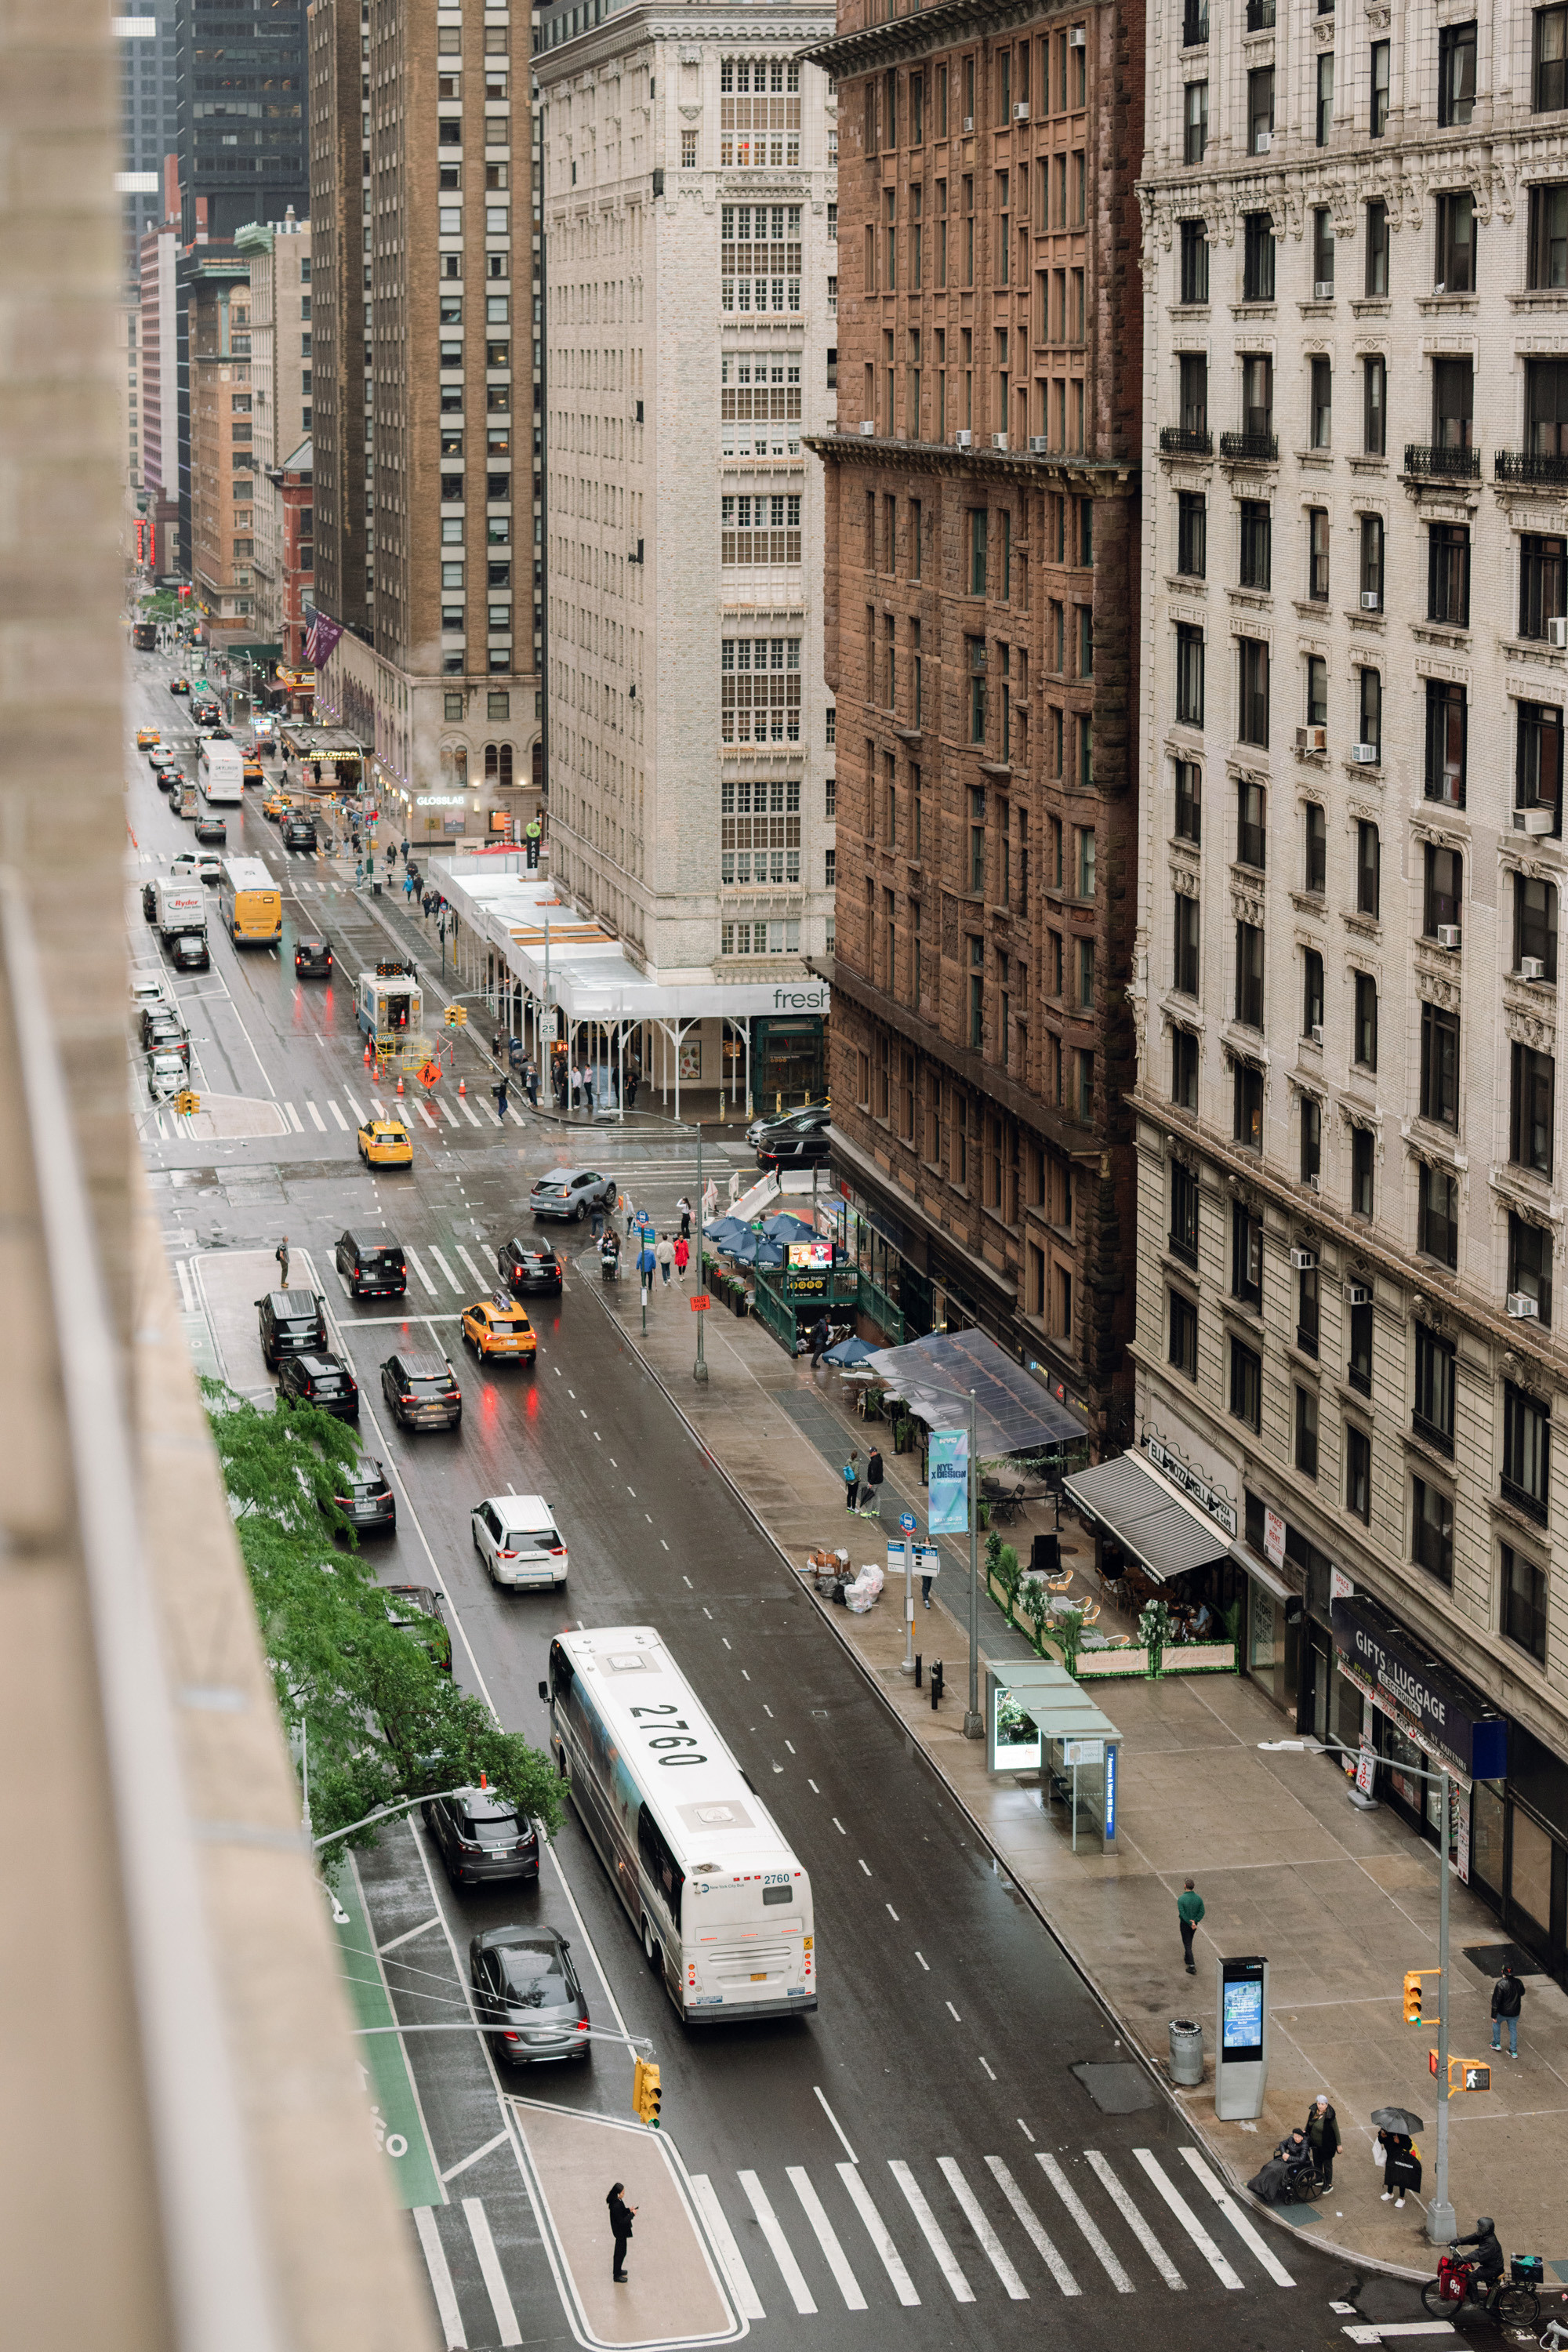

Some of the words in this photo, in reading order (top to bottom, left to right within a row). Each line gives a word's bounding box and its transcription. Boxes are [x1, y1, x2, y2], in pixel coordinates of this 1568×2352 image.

[417, 796, 464, 805] GLOSSLAB
[1169, 1459, 1211, 1505] MOZZRELLA
[1268, 1512, 1283, 1530] SPACE
[1269, 1530, 1280, 1544] RENT
[1335, 1573, 1349, 1592] SPACE
[1354, 1662, 1362, 1674] NY
[1365, 1672, 1372, 1683] PD
[1356, 1630, 1385, 1671] GIFTS
[1394, 1662, 1446, 1726] LUGGAGE
[1381, 1674, 1419, 1715] ELECTRONICS
[1403, 1706, 1417, 1726] TAXI
[630, 1704, 707, 1766] 2760
[1430, 1732, 1438, 1744] NY
[1440, 1741, 1467, 1772] SOUVENIRS
[1361, 1762, 1367, 1775] 3
[764, 1874, 789, 1884] 2760
